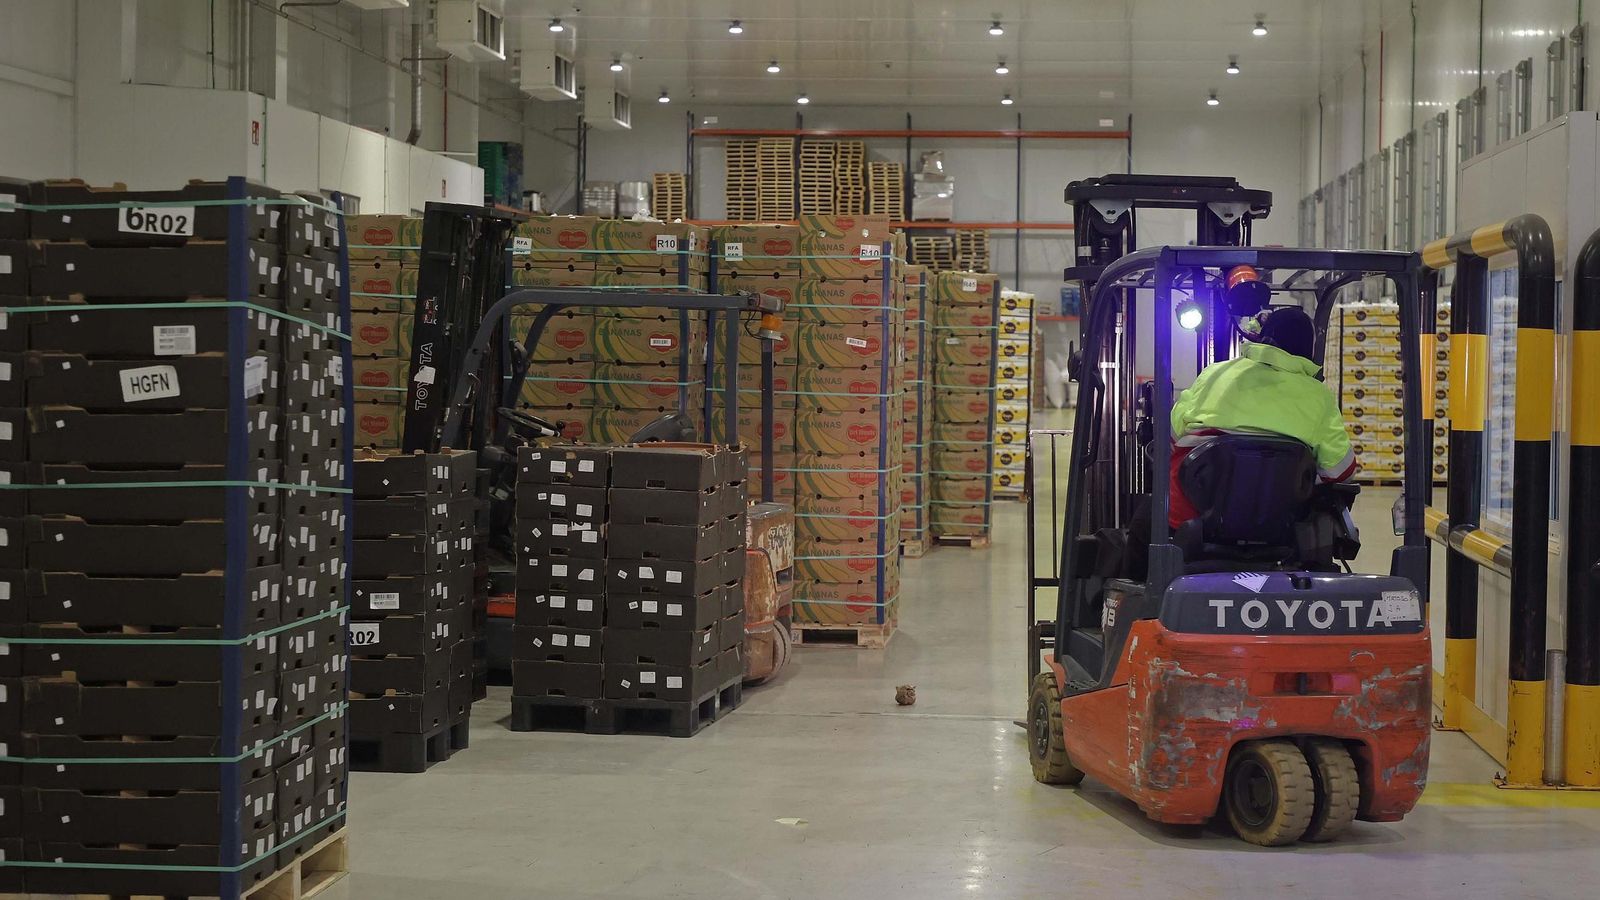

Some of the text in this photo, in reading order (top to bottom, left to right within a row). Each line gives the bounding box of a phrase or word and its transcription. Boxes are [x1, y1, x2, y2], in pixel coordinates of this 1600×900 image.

[657, 239, 675, 249] R10
[130, 372, 171, 395] HGFN
[1208, 599, 1393, 628] TOYOTA
